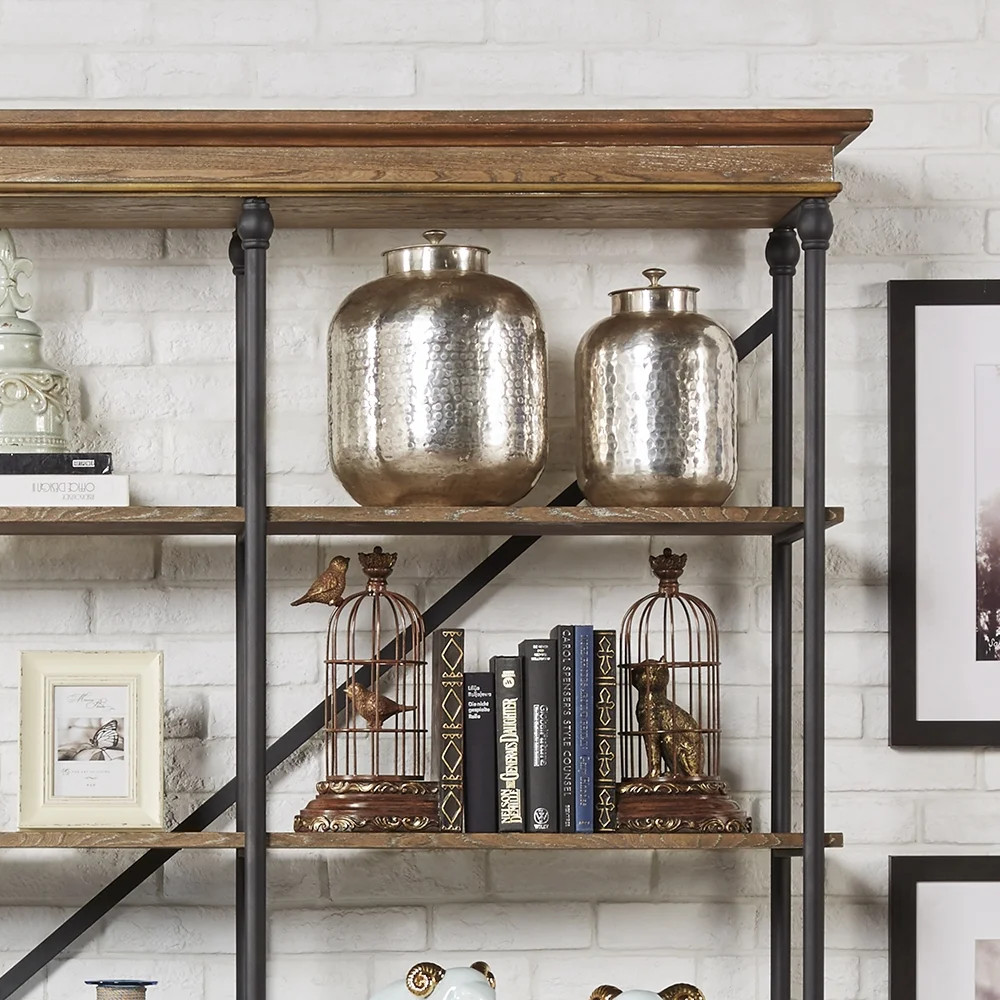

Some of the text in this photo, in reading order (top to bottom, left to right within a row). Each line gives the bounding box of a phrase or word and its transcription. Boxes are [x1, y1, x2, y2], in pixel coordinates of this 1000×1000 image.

[562, 629, 571, 662] CAROL
[563, 666, 571, 716] SPENSER'S
[499, 697, 519, 743] DAUGHTER
[563, 719, 572, 747] STYLE
[563, 751, 572, 796] COUNSEL
[501, 789, 510, 824] NELSON
